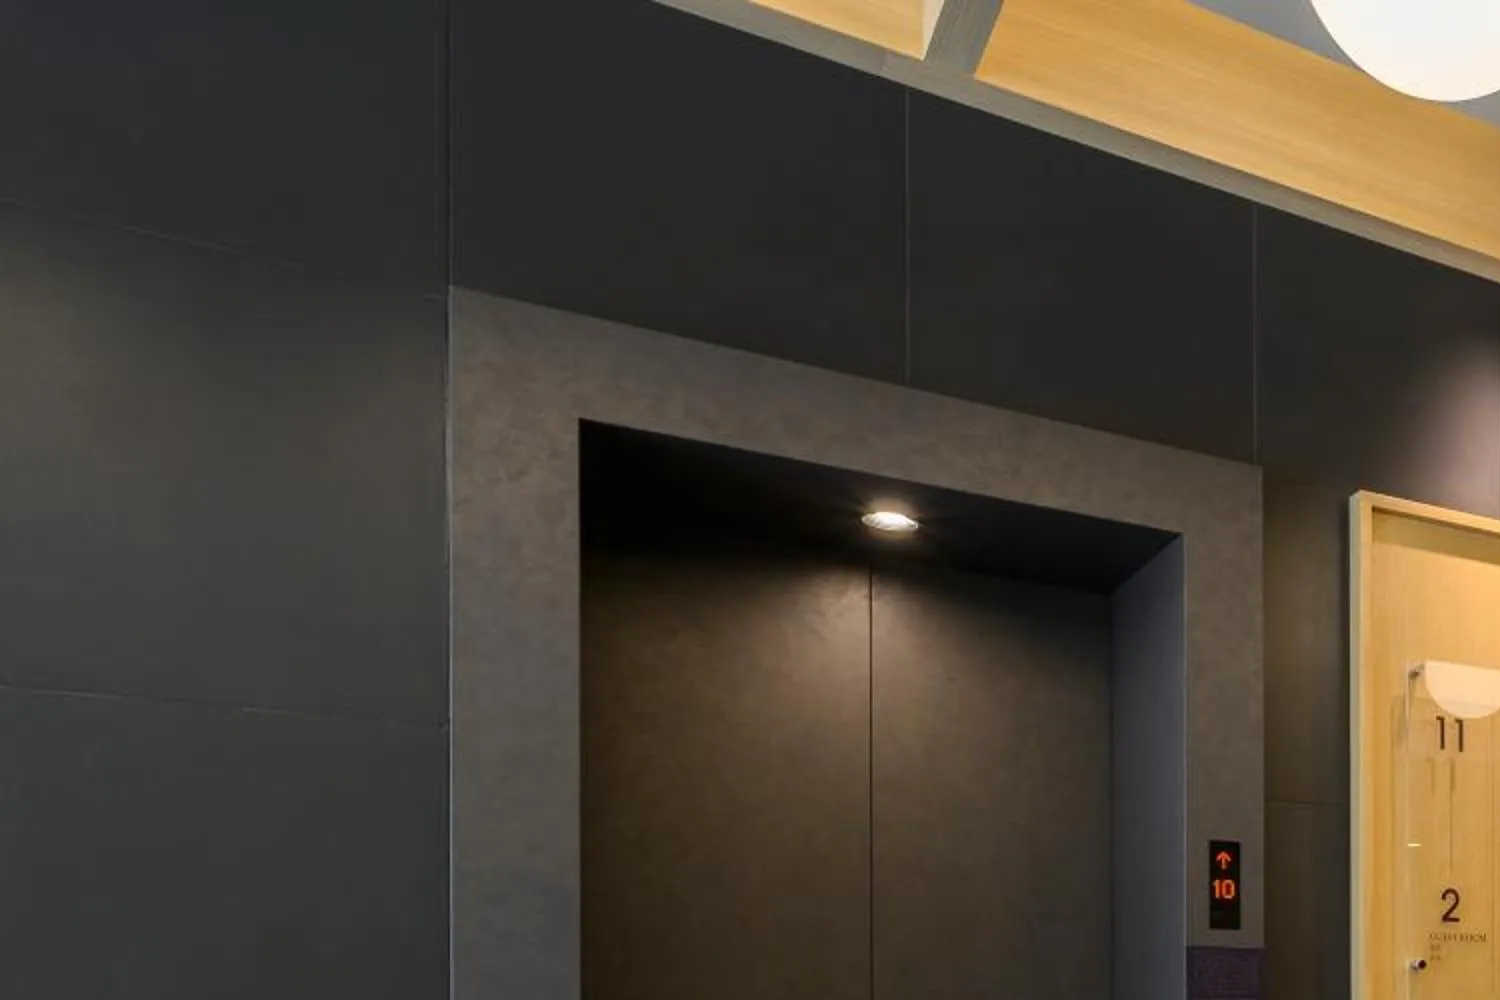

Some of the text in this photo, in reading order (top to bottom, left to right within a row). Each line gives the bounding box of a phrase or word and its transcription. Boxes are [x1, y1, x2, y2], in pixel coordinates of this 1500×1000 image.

[1435, 715, 1465, 753] 11
[1212, 879, 1235, 899] 10
[1440, 887, 1461, 923] 2
